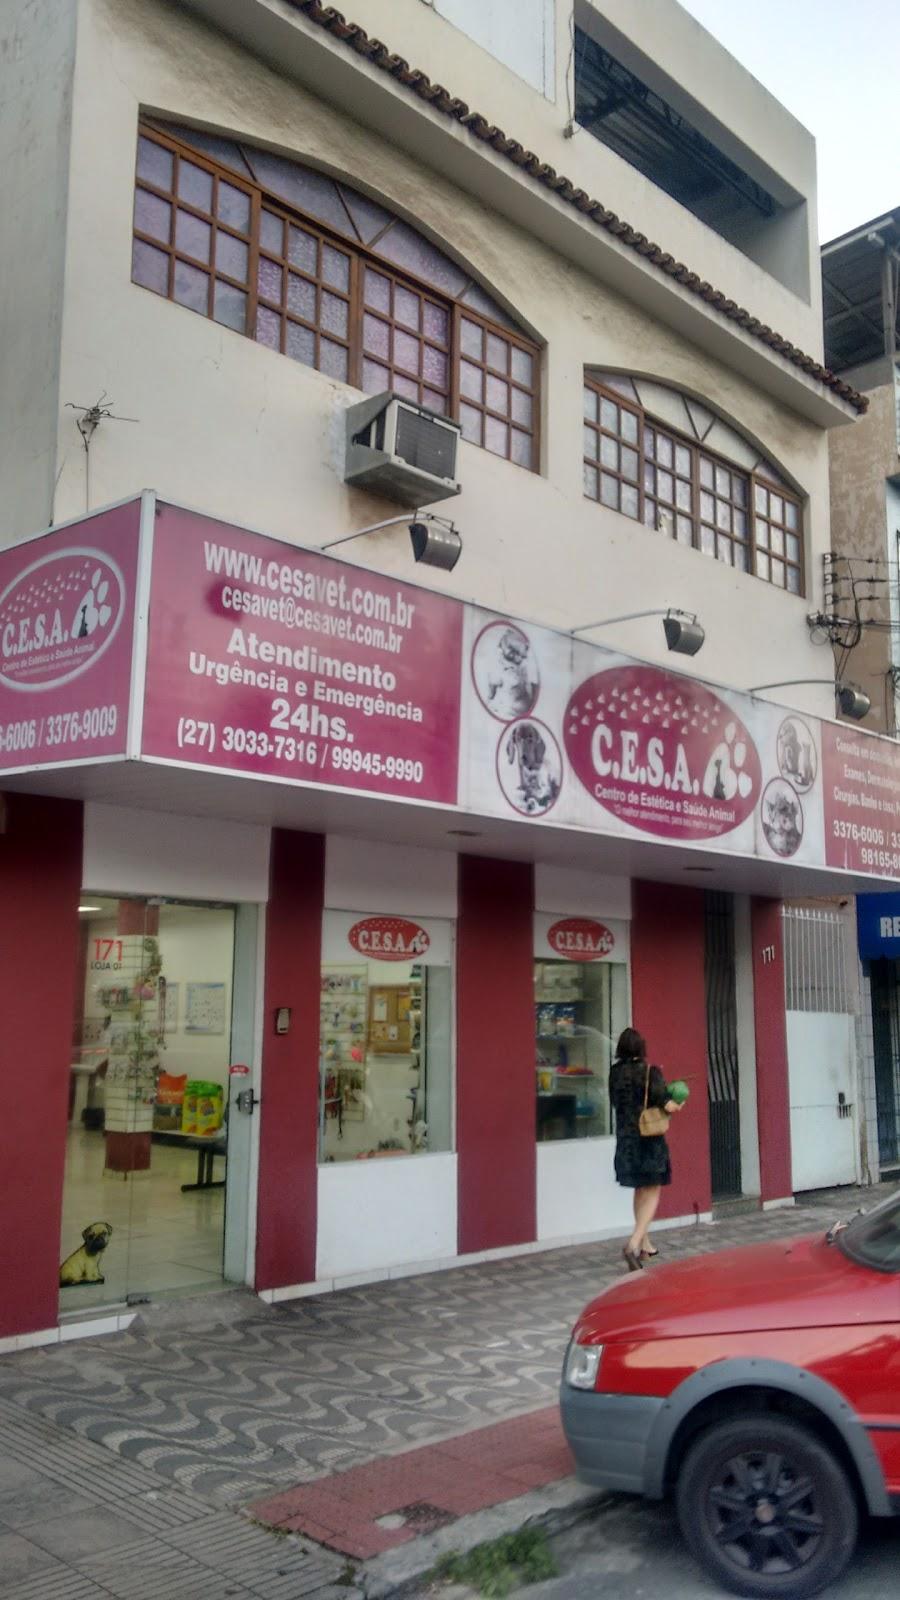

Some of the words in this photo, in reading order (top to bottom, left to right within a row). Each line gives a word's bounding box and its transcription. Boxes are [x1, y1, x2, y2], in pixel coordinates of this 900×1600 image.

[204, 541, 415, 629] www.cesavet.com.br
[2, 608, 69, 657] C.E.S.A.
[222, 586, 402, 653] cesavet@cesavet.com.br
[227, 628, 396, 691] Atendimento
[189, 651, 288, 694] Urgência
[294, 681, 308, 697] e
[313, 682, 423, 723] Emergência
[46, 704, 117, 746] 3376-9009
[270, 698, 354, 743] 24hs.
[177, 717, 216, 752] (27)
[222, 726, 317, 765] 3033-7316
[332, 746, 423, 783] 99945-9990
[592, 723, 700, 796] C.E.S.A.
[594, 783, 626, 802] Centro
[627, 790, 640, 804] de
[641, 792, 675, 811] Estética
[676, 801, 682, 813] e
[683, 800, 708, 818] Saúde
[709, 806, 736, 823] Animal
[833, 820, 884, 845] 3376-6006
[861, 847, 900, 870] 98165-8
[91, 961, 111, 970] LOJA
[95, 939, 123, 961] 171
[762, 944, 775, 965] 171
